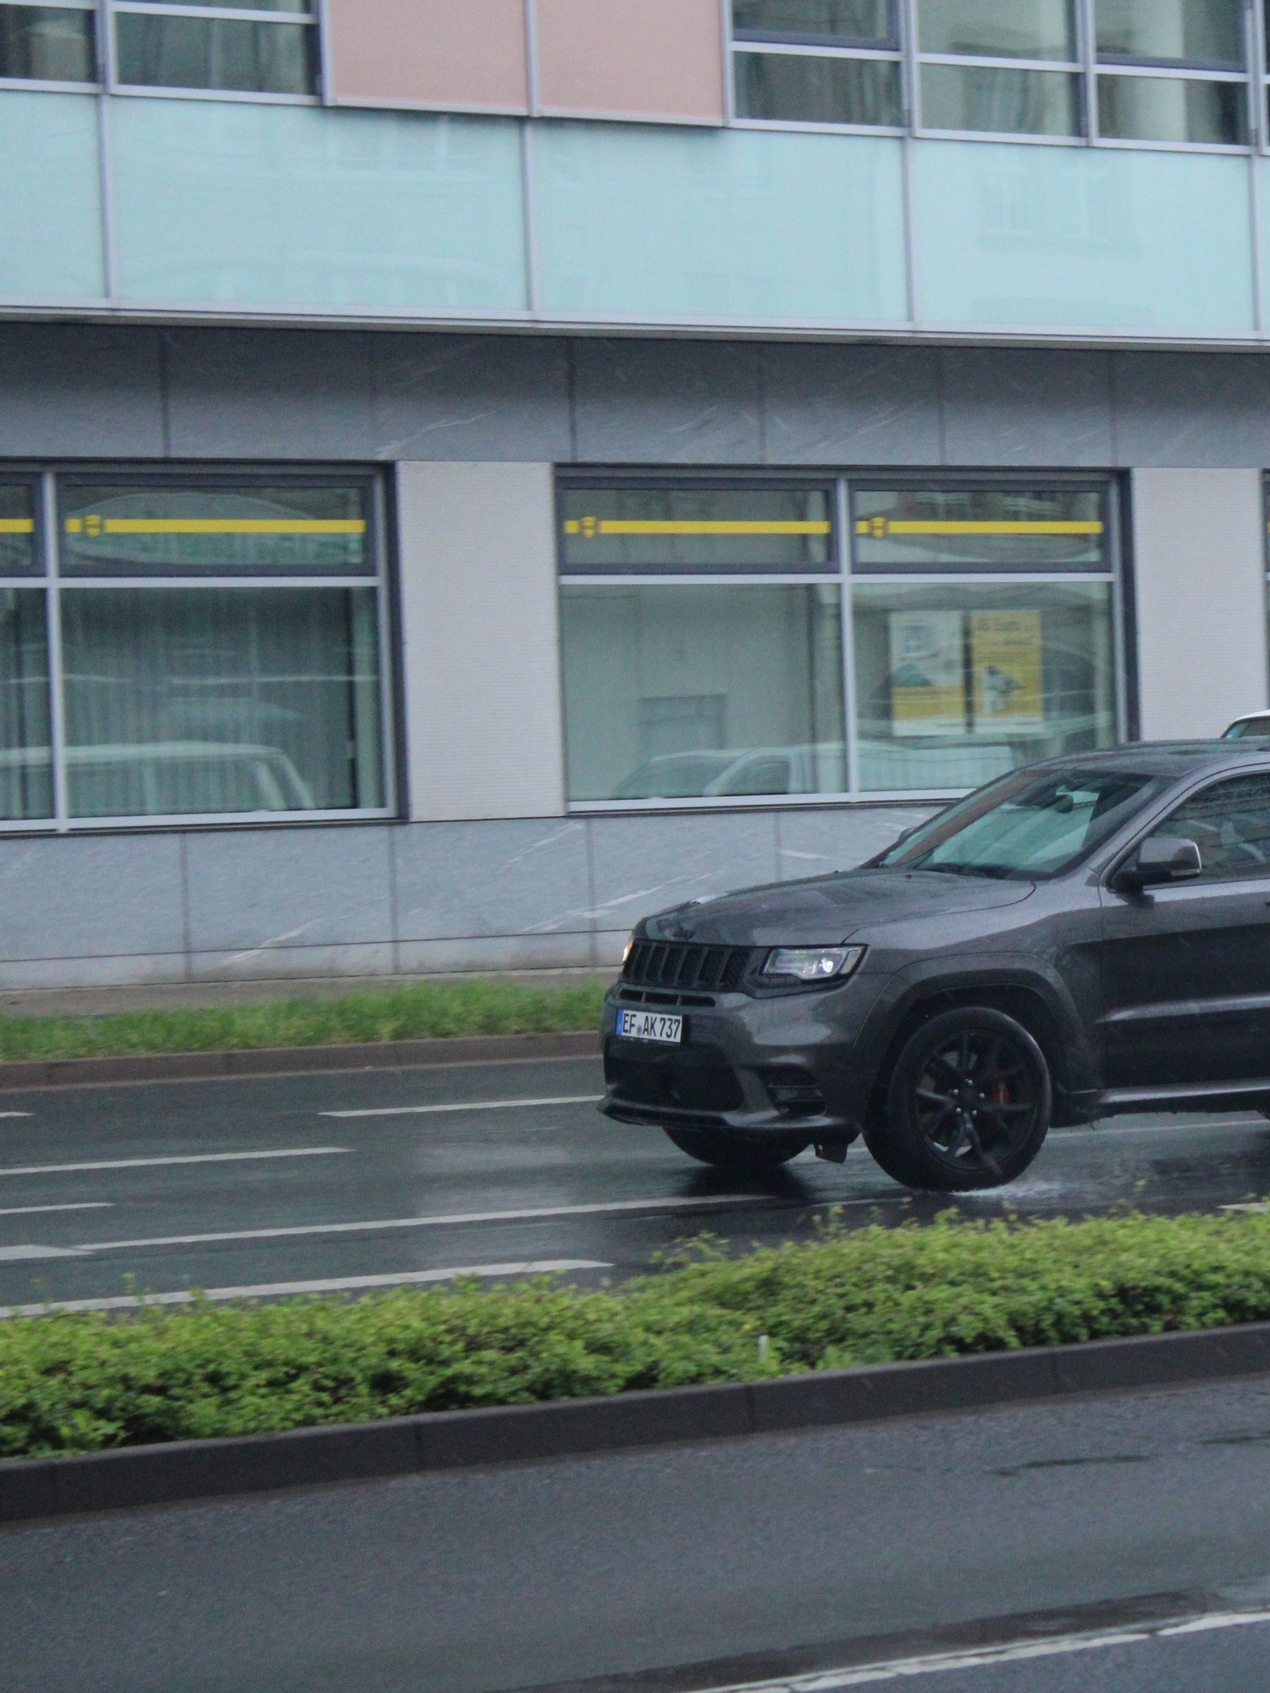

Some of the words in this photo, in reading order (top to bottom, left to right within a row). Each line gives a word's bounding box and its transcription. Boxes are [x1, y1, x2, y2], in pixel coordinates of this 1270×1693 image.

[622, 1013, 637, 1034] EF
[642, 1015, 658, 1037] AK
[659, 1017, 681, 1039] 737
